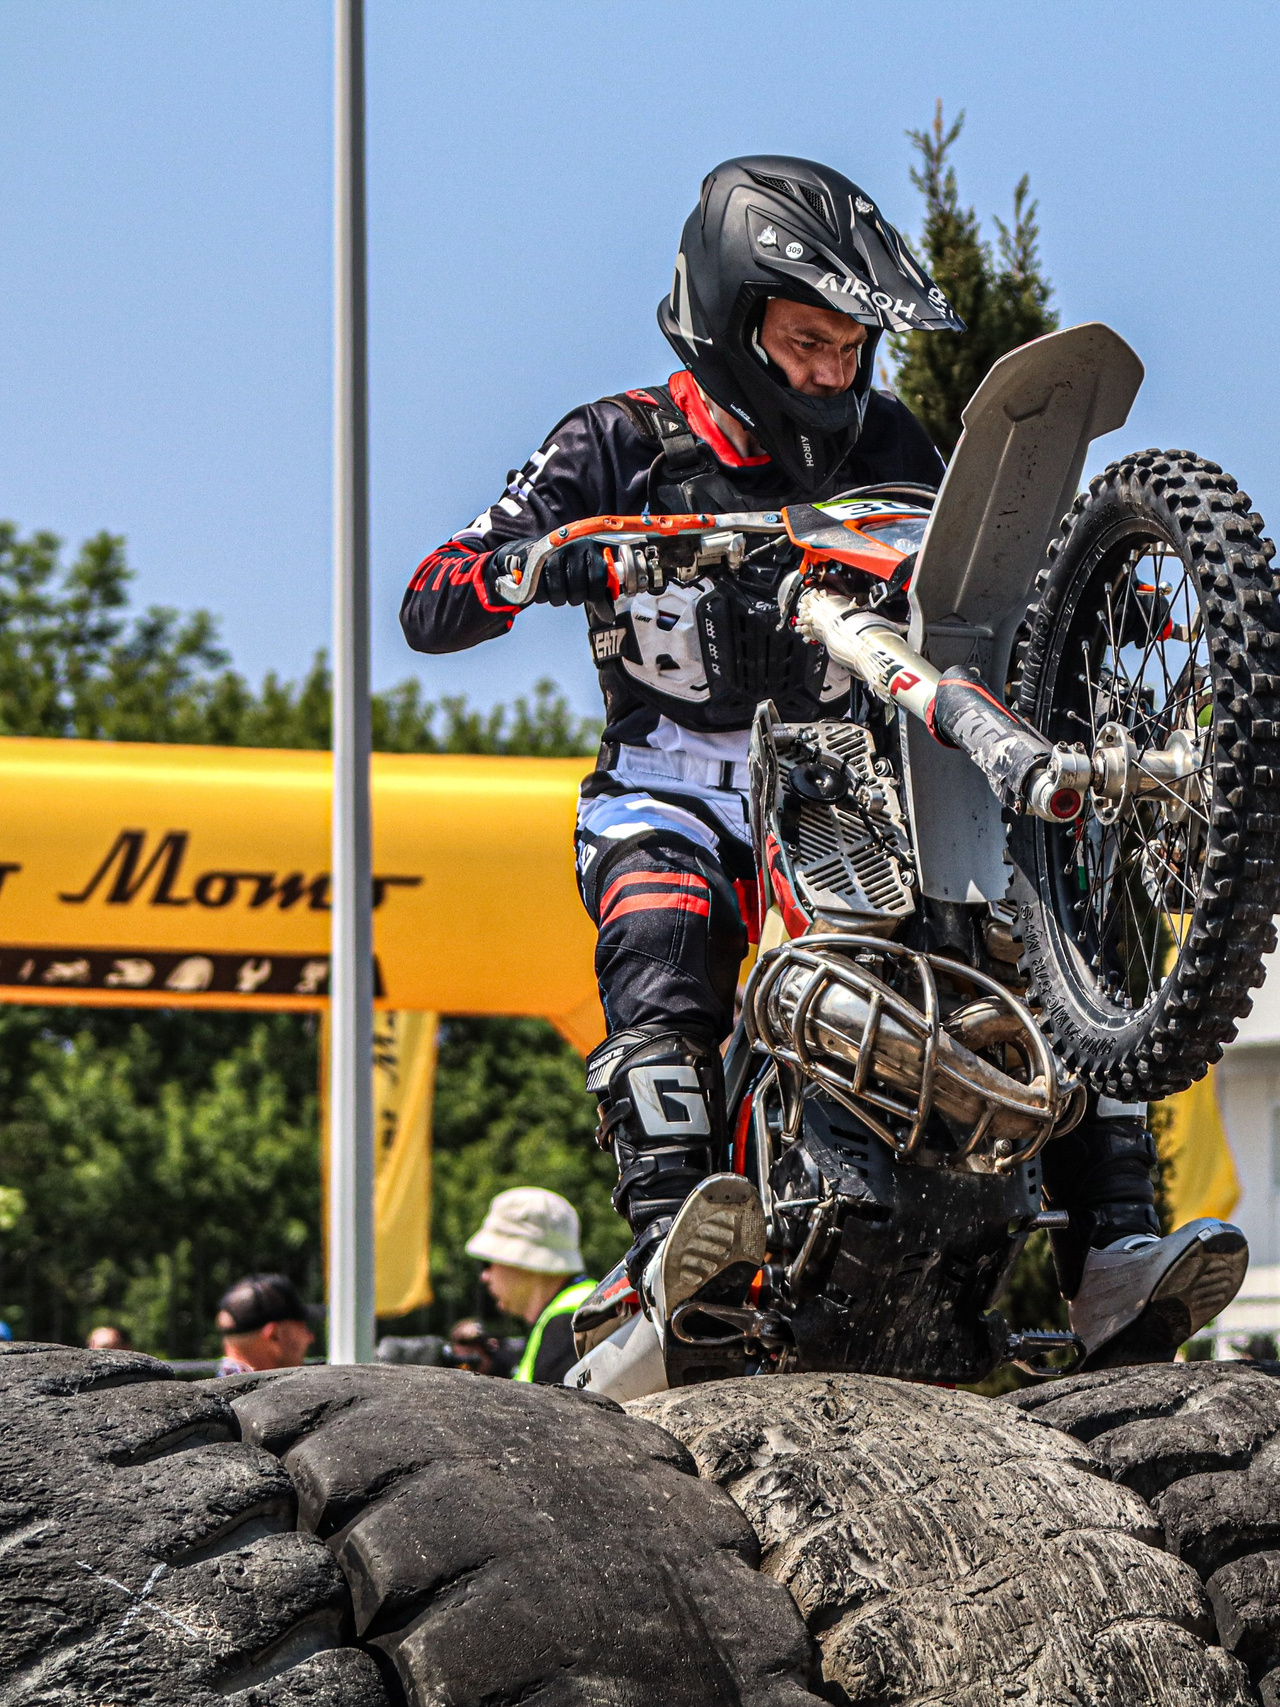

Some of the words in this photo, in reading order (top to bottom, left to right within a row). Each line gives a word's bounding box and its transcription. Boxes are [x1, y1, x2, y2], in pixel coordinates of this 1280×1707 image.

[786, 245, 802, 255] 309
[816, 272, 916, 319] AIROH
[800, 434, 815, 467] AIROH
[593, 627, 627, 659] EATT
